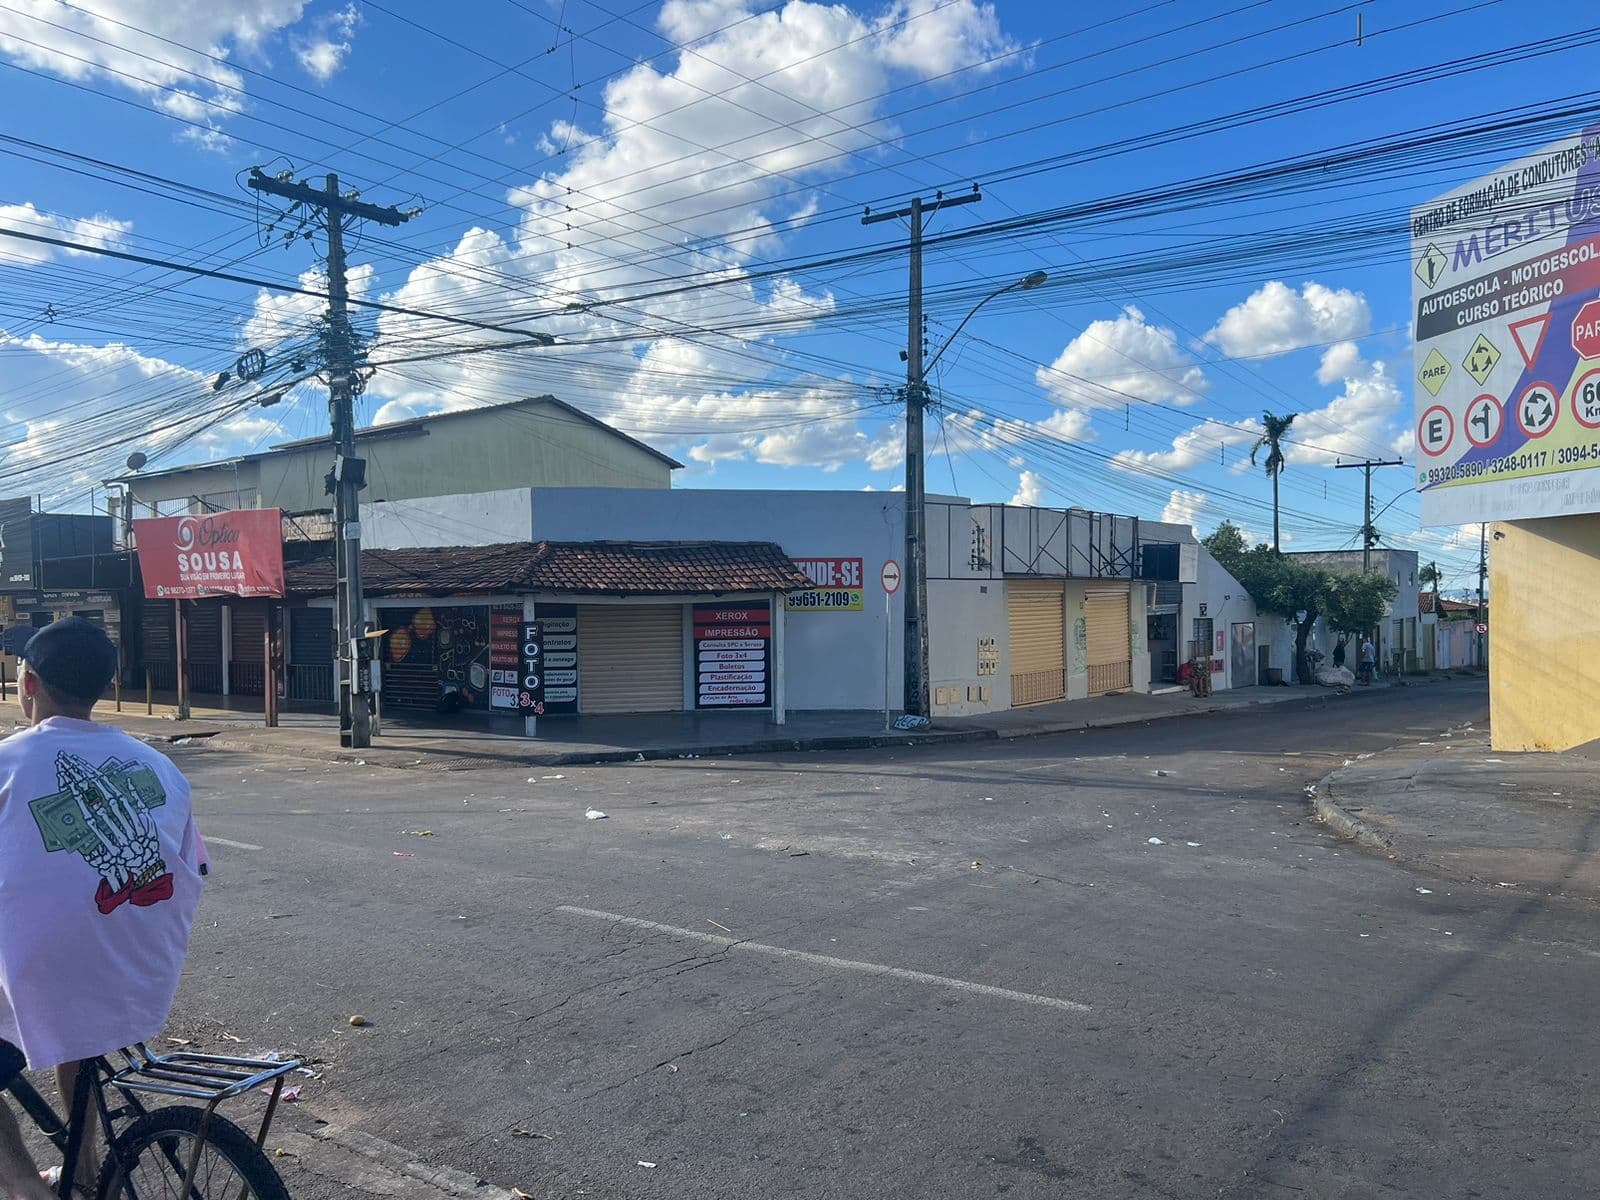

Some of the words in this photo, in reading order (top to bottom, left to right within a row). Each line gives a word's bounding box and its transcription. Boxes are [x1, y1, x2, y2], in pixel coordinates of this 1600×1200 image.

[1413, 208, 1443, 238] CENTRO
[1445, 203, 1457, 226] DE
[1458, 178, 1505, 218] FORMAÇÃO
[1508, 172, 1520, 197] DE
[1522, 143, 1586, 190] CONDUTORES
[1422, 277, 1500, 316] AUTOESCOLA
[1511, 242, 1600, 286] MOTOESCOL
[1457, 297, 1499, 326] CURSO
[1502, 278, 1564, 311] TEÓRICO
[1423, 365, 1447, 379] PARE
[1428, 418, 1443, 443] E
[1491, 451, 1547, 474] 3248-0117
[1558, 443, 1600, 464] 3094-5
[178, 551, 244, 572] SOUSA
[793, 561, 859, 586] NDE-SE
[715, 611, 748, 620] XEROX
[704, 627, 759, 637] IMPRESSÃO
[524, 627, 539, 689] FOTO
[492, 688, 510, 696] FOTO
[520, 692, 545, 714] 3x4
